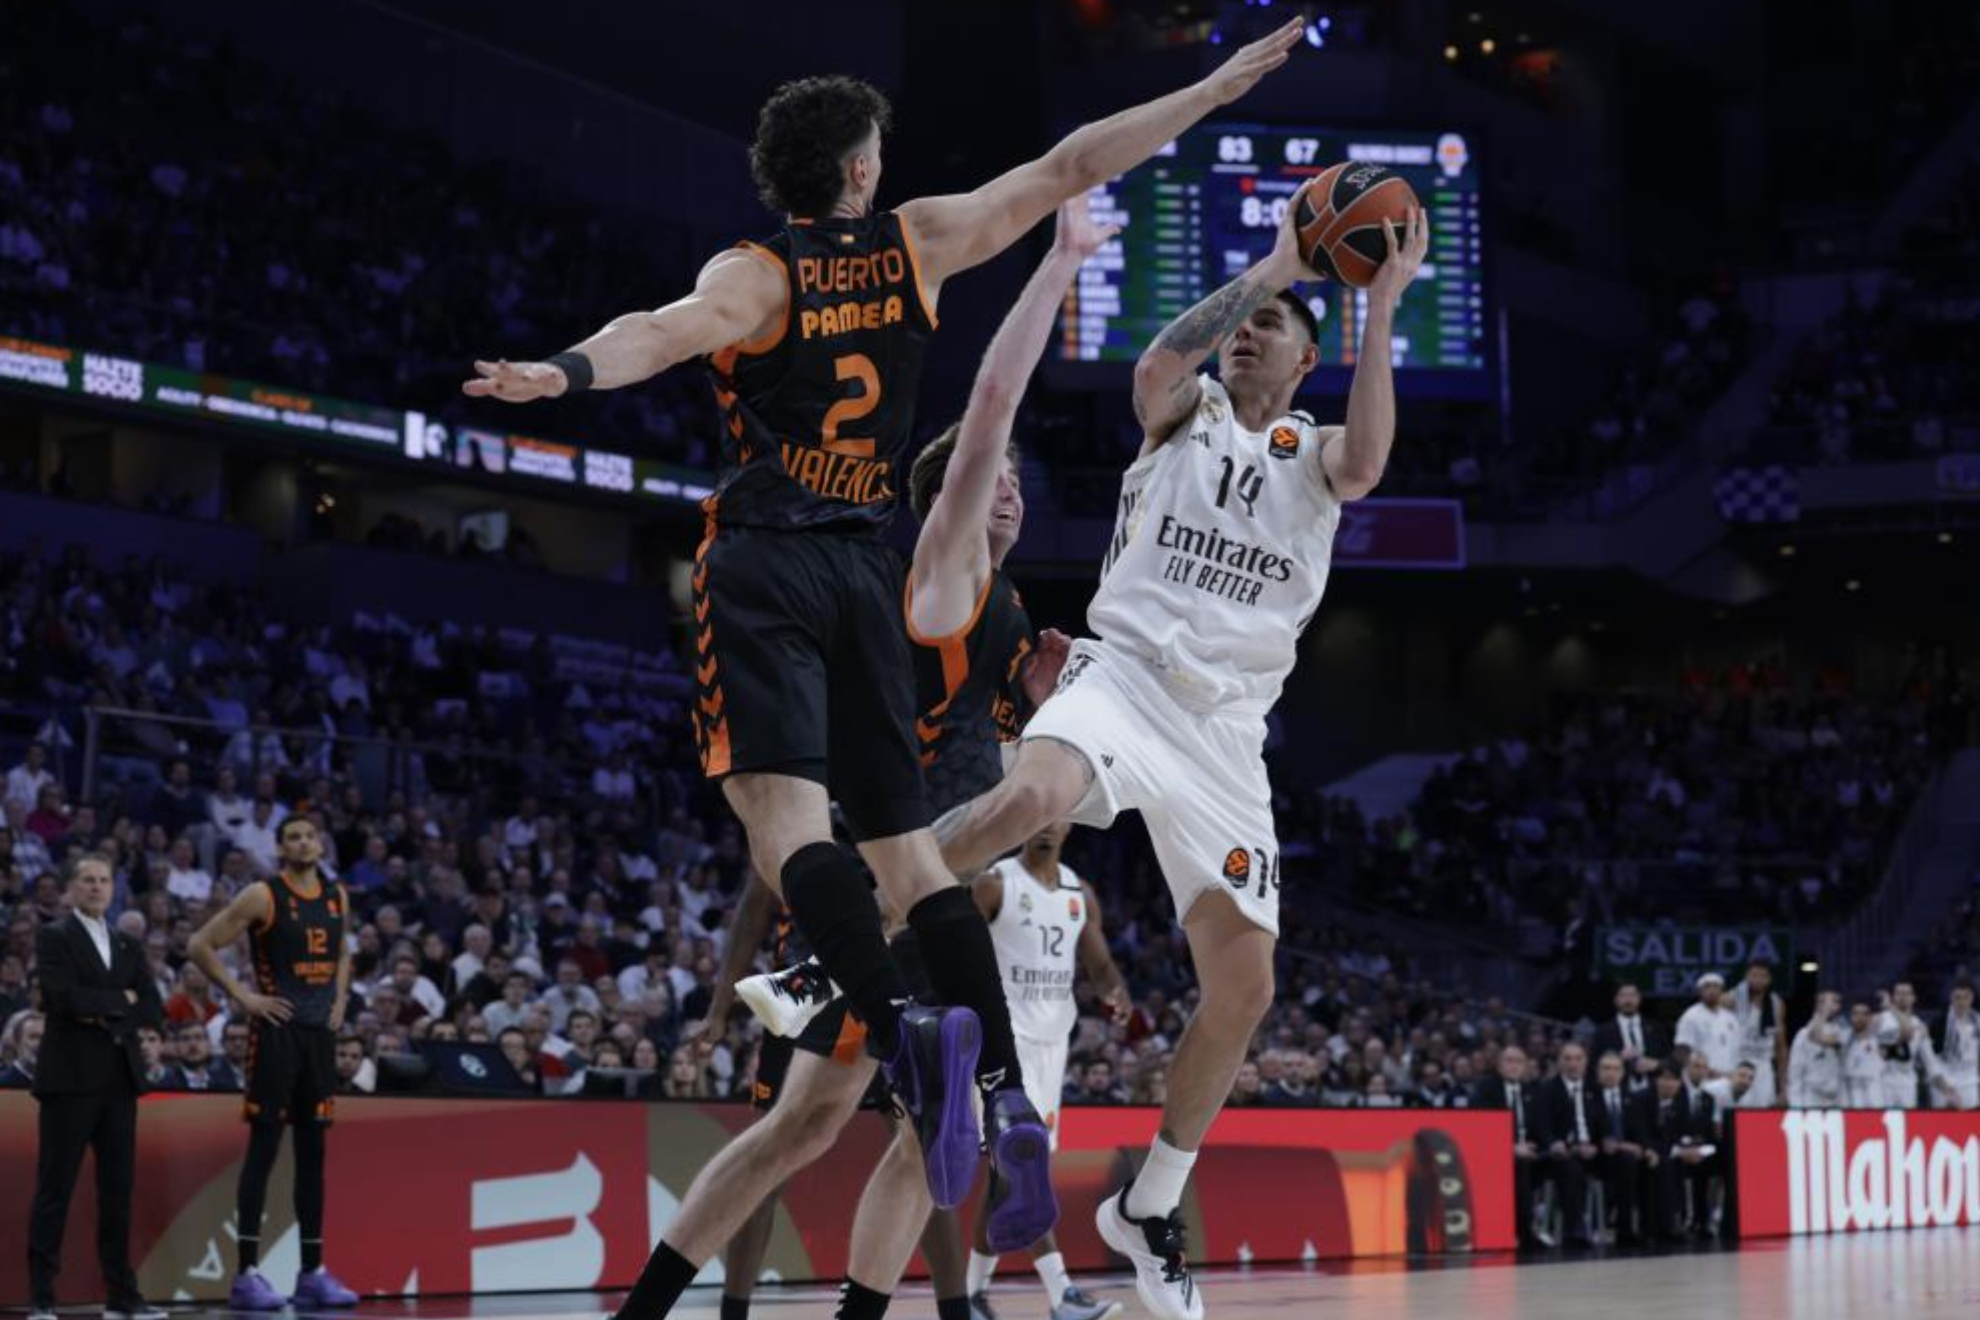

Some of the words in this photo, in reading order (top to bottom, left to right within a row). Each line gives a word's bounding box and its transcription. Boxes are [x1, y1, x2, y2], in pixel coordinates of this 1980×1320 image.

[1241, 195, 1290, 227] 8:0
[798, 247, 905, 294] PUERTO
[820, 352, 882, 458] 2
[1214, 455, 1264, 517] 14
[1155, 514, 1295, 582] Emirates
[1163, 555, 1193, 584] FLY
[1195, 564, 1263, 606] BETTER
[305, 927, 329, 954] 12
[1038, 924, 1065, 957] 12
[1605, 929, 1781, 966] SALIDA
